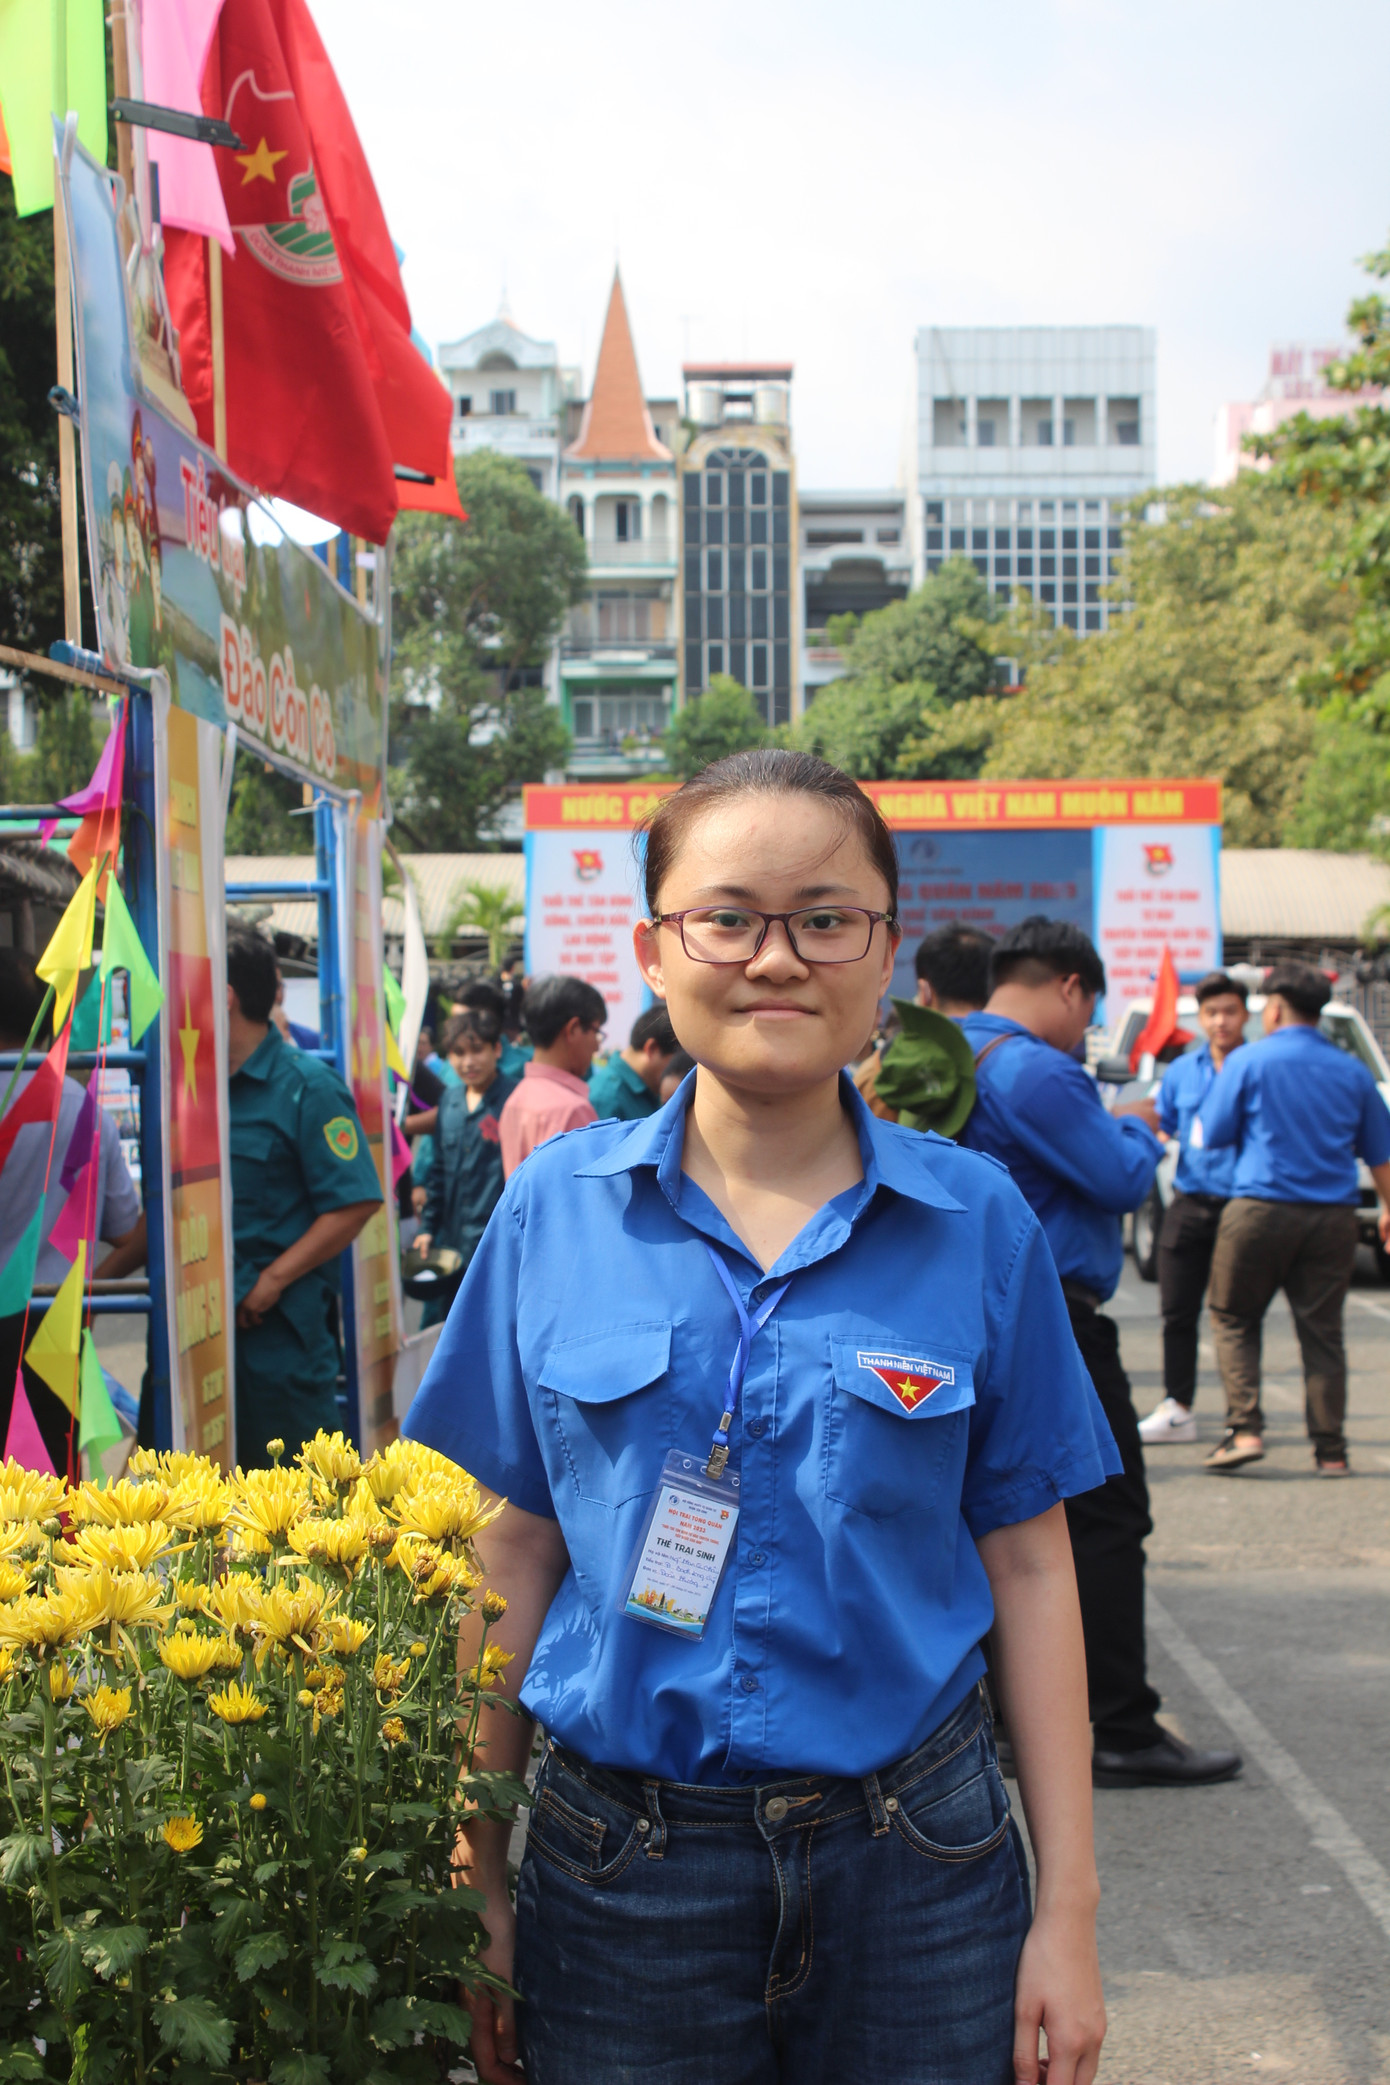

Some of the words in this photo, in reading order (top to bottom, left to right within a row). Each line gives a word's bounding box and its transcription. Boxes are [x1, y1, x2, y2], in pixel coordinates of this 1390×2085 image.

[181, 454, 219, 569] Tiểu
[222, 616, 266, 734] Đảo
[270, 647, 309, 761] Cồn
[562, 790, 623, 822] NƯỚC
[952, 788, 999, 822] VIỆT
[1006, 791, 1055, 818] NAM
[1062, 786, 1127, 817] MUÔN
[1133, 785, 1183, 816] NĂM
[862, 1357, 894, 1368] THANH
[894, 1360, 914, 1371] NIÊN
[915, 1363, 933, 1376] VIỆT
[933, 1368, 951, 1380] NAM
[657, 1536, 672, 1548] THẺ
[674, 1543, 694, 1556] TRẠI
[696, 1550, 716, 1562] SINH
